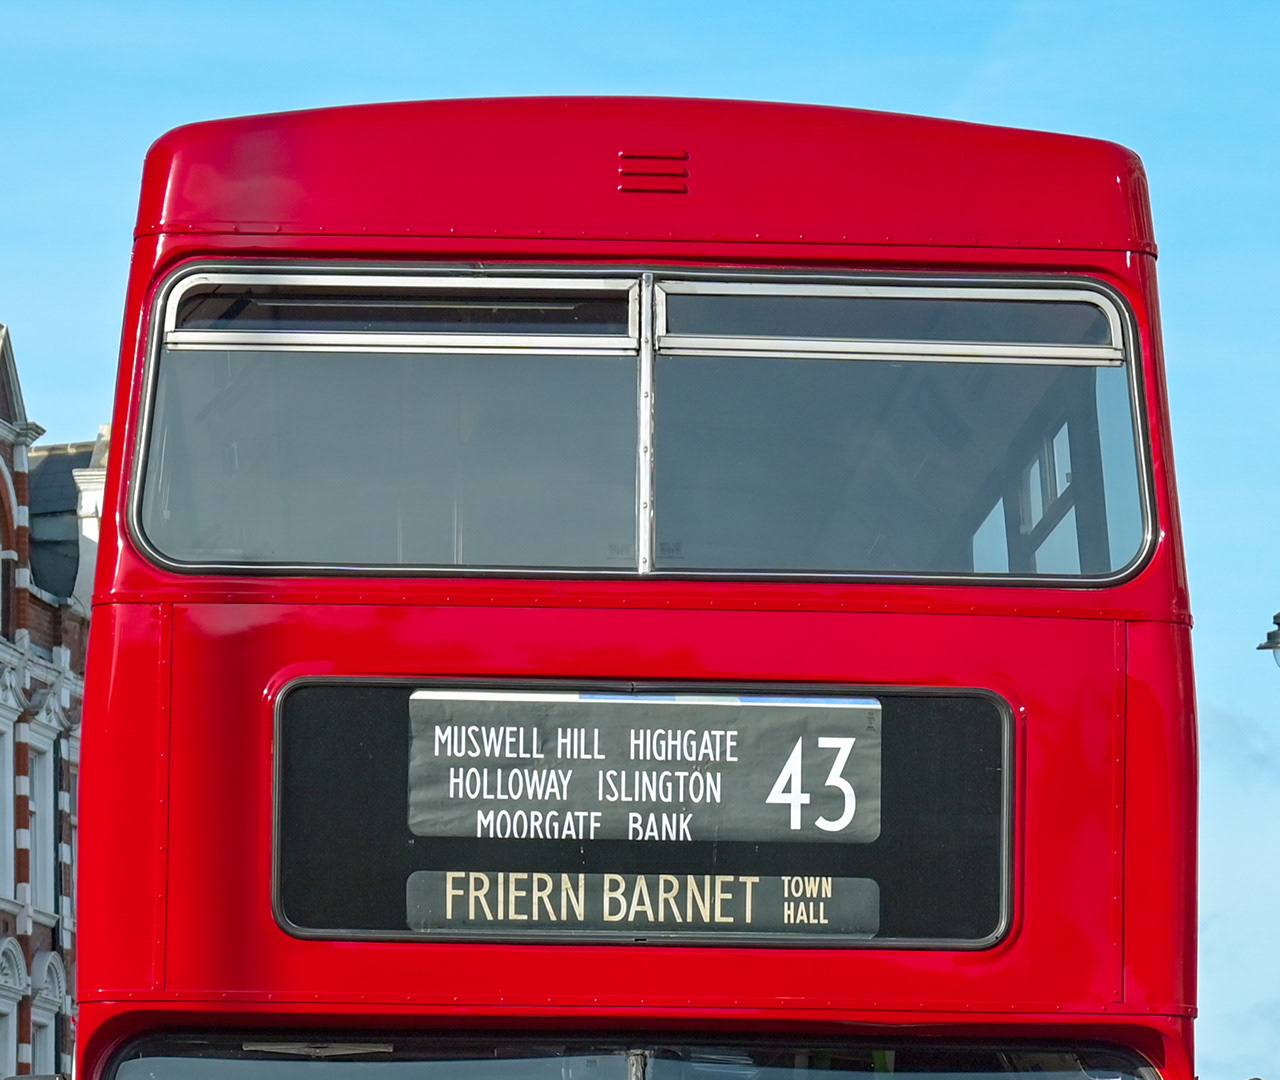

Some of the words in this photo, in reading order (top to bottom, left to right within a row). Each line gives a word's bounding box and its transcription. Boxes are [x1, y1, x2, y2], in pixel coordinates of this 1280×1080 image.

[434, 725, 544, 759] MUSWELL
[557, 727, 606, 760] HILL
[630, 729, 738, 762] HIGHGATE
[449, 767, 573, 801] HOLLOWAY
[598, 769, 721, 804] ISLINGTON
[765, 735, 857, 832] 43
[628, 812, 693, 842] BANK
[445, 871, 585, 922] FRIERN
[602, 873, 760, 924] BARNET
[780, 875, 833, 898] TOWN
[782, 901, 829, 925] HALL
